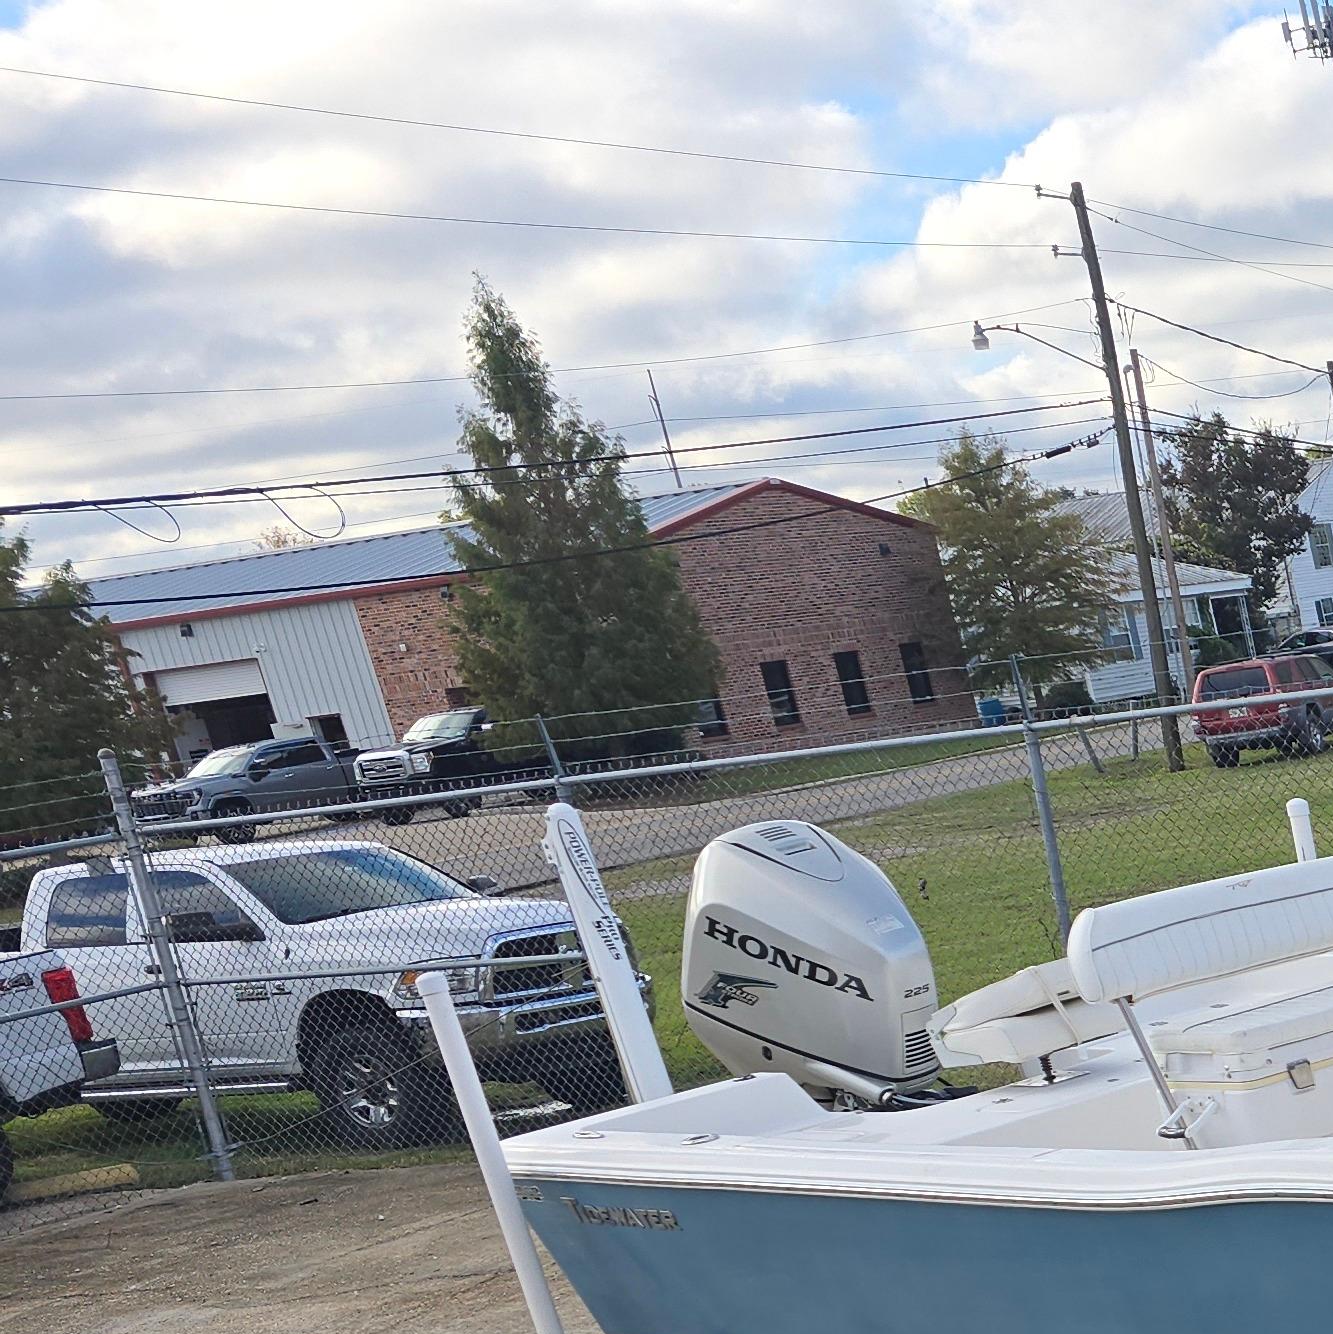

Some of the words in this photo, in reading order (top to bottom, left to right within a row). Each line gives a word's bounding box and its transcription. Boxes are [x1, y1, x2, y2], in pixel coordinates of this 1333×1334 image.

[592, 920, 622, 960] SERIES
[601, 915, 620, 940] PRO
[704, 916, 874, 1002] HONDA
[717, 982, 758, 1000] FOUR
[904, 983, 929, 998] 225
[560, 1196, 680, 1230] TIDEWATER
